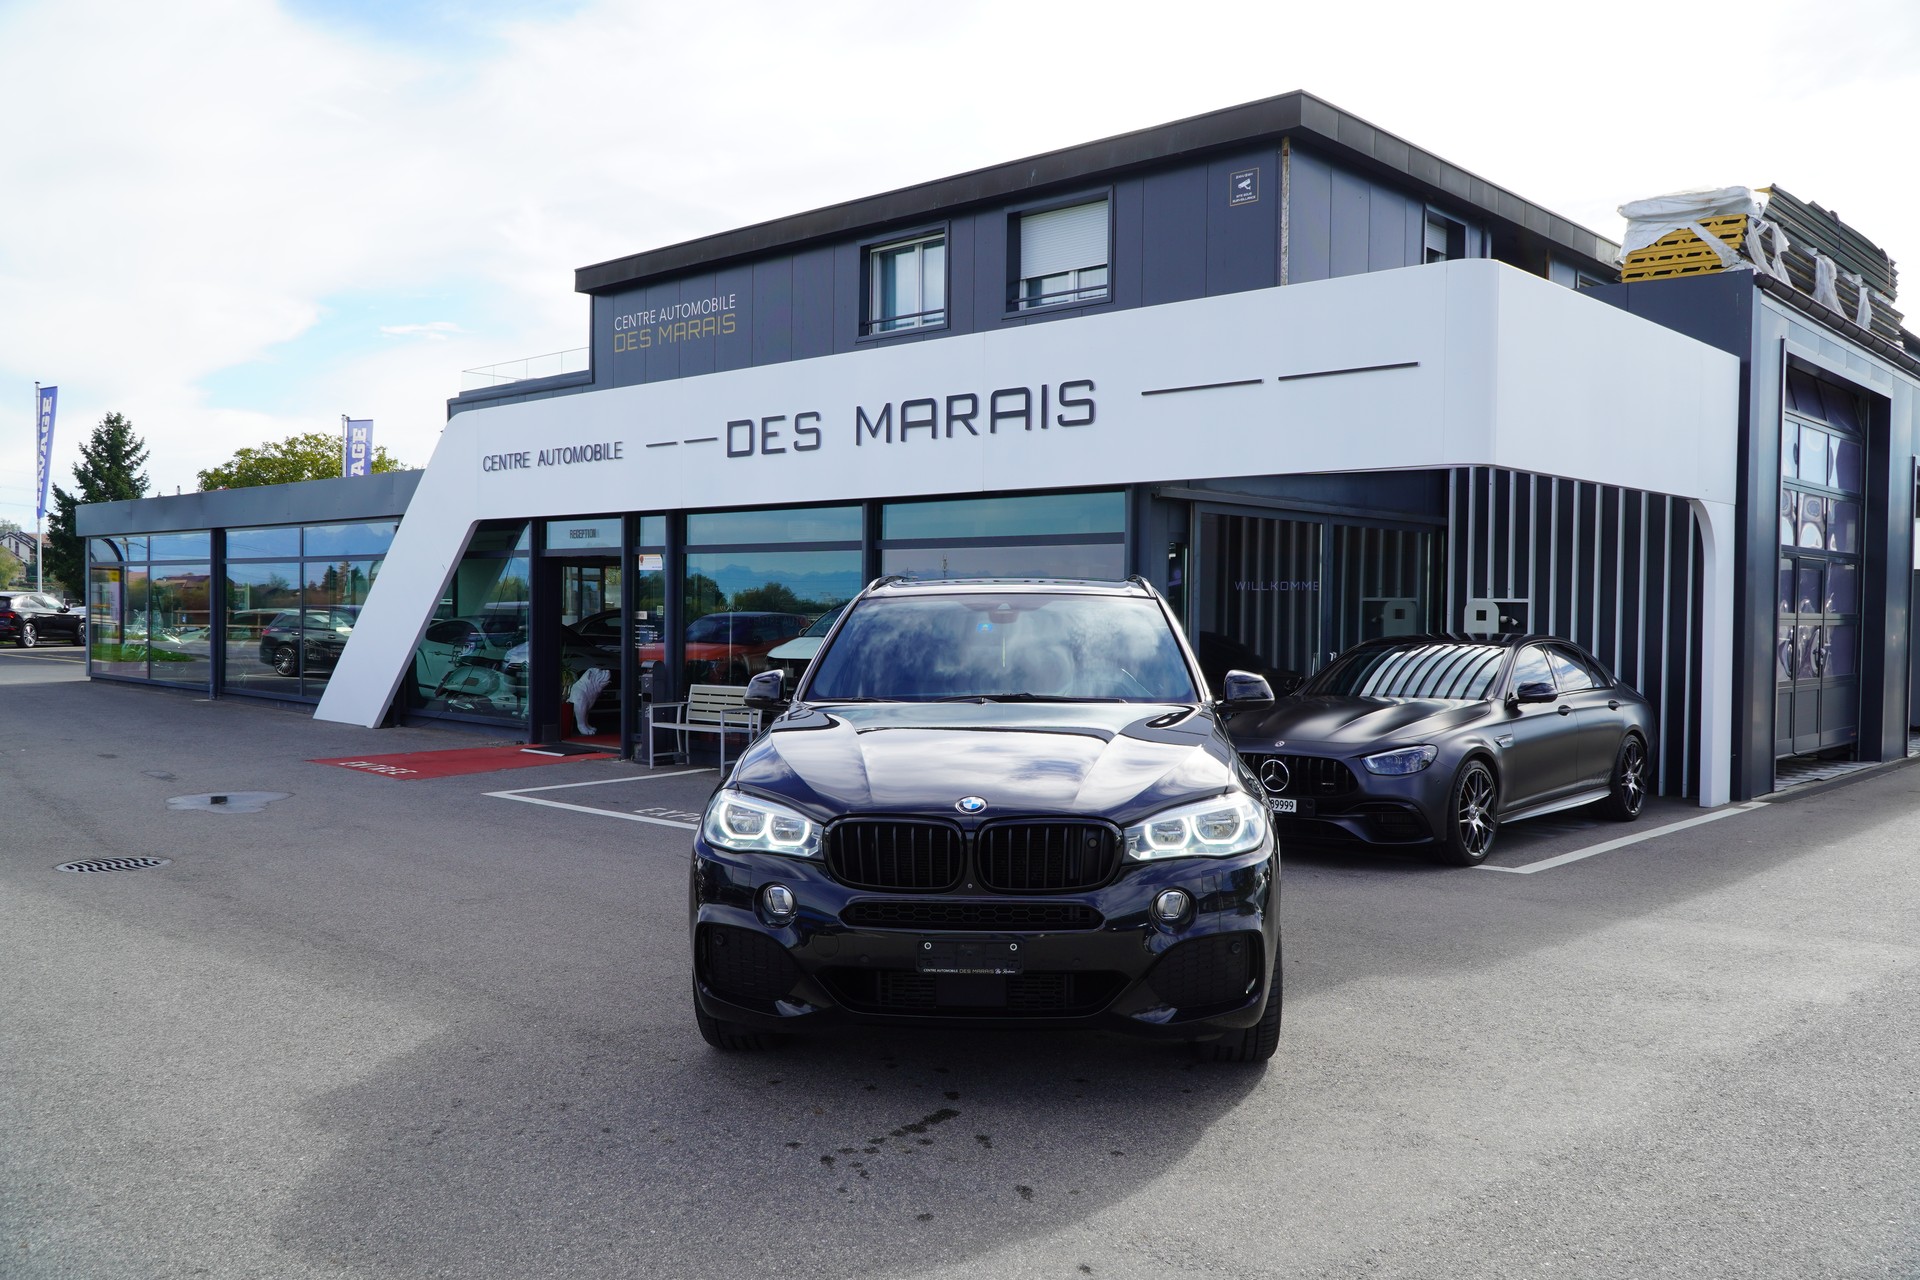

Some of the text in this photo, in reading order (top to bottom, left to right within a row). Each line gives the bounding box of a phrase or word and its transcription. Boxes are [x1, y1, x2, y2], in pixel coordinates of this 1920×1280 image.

[614, 293, 736, 331] CENTRE AUTOMOBILE
[614, 313, 736, 353] DES MARAIS
[482, 379, 1096, 472] CENTRE AUTOMOBILE DES MARAIS
